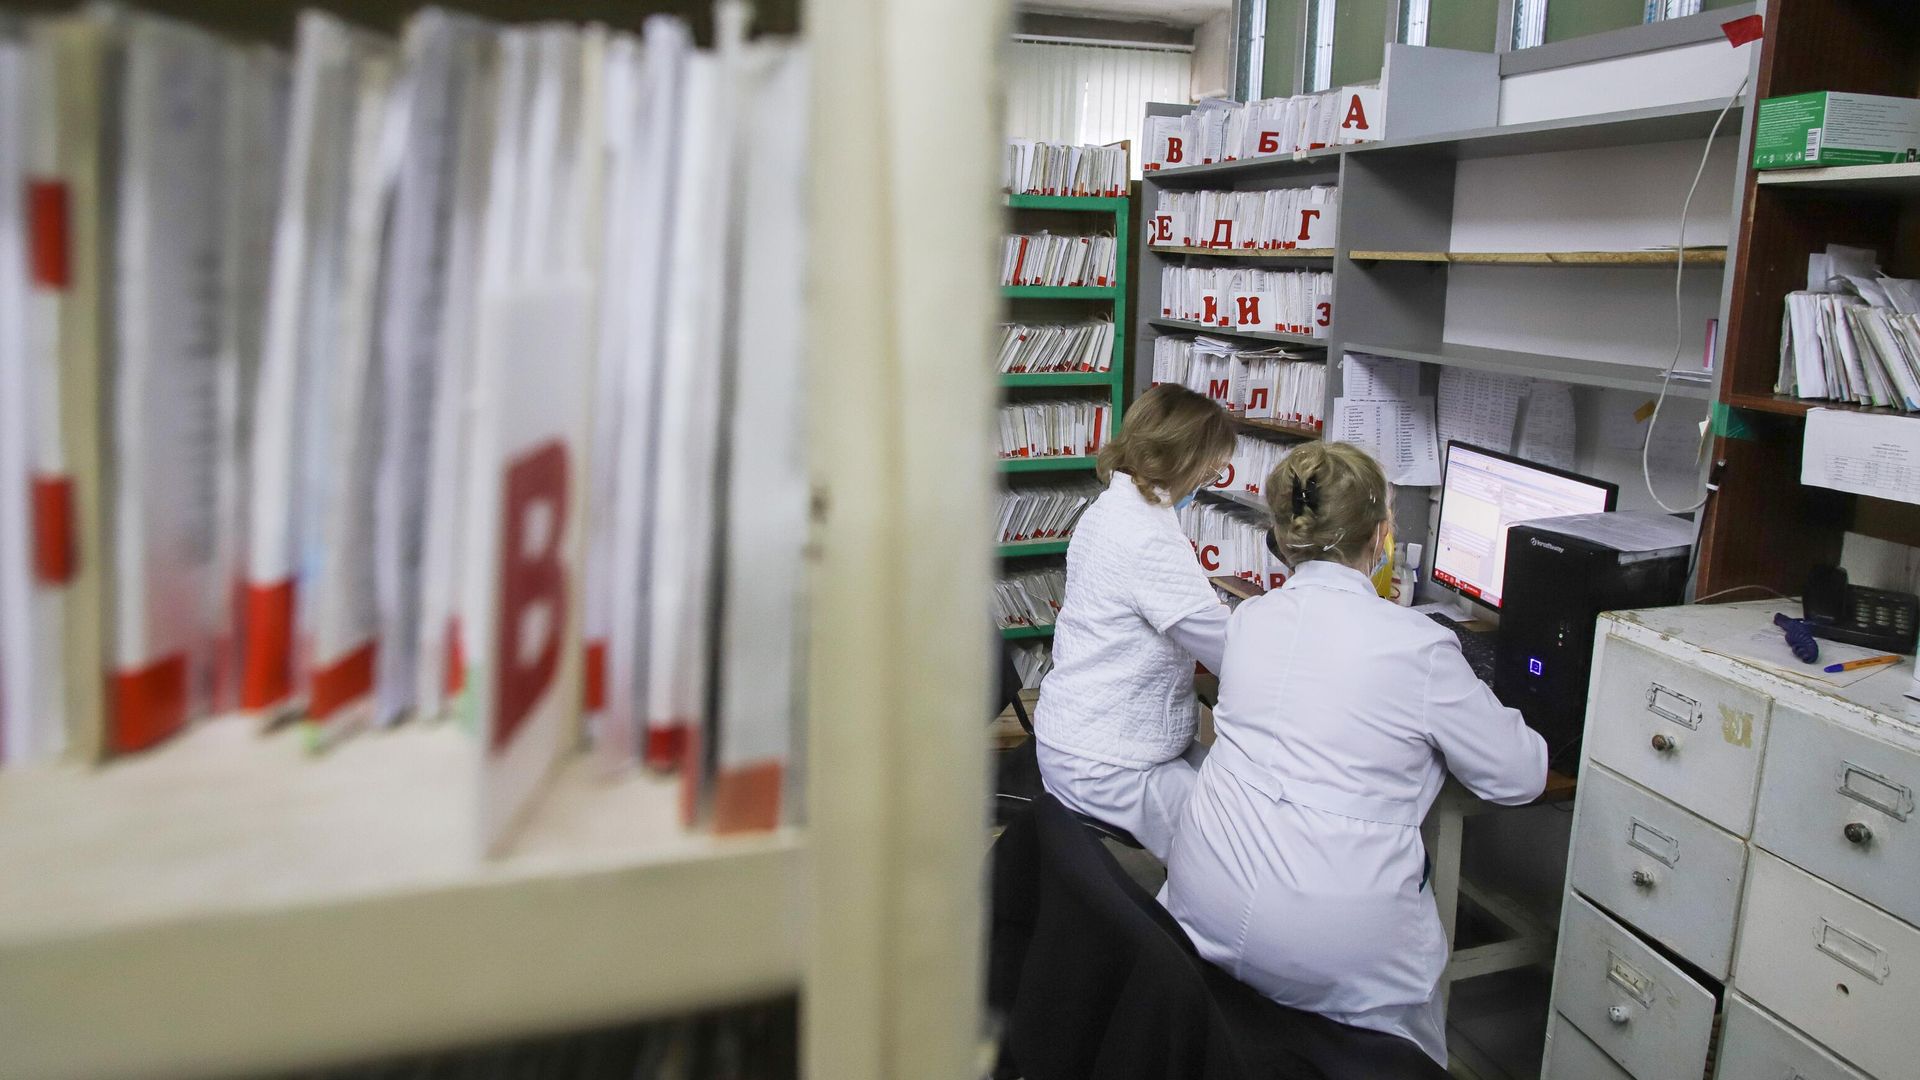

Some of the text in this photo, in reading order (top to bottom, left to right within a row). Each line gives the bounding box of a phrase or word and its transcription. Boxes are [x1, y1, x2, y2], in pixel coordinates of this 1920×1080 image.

[1342, 94, 1369, 129] А
[1166, 137, 1183, 163] В
[1258, 132, 1279, 152] Б
[1157, 216, 1172, 240] Е
[1209, 220, 1232, 248] Д
[1298, 210, 1320, 240] Г
[1237, 297, 1261, 324] И
[1317, 303, 1331, 326] З
[1210, 380, 1229, 399] М
[1248, 388, 1268, 410] Л
[1201, 545, 1220, 571] С
[492, 437, 571, 757] В
